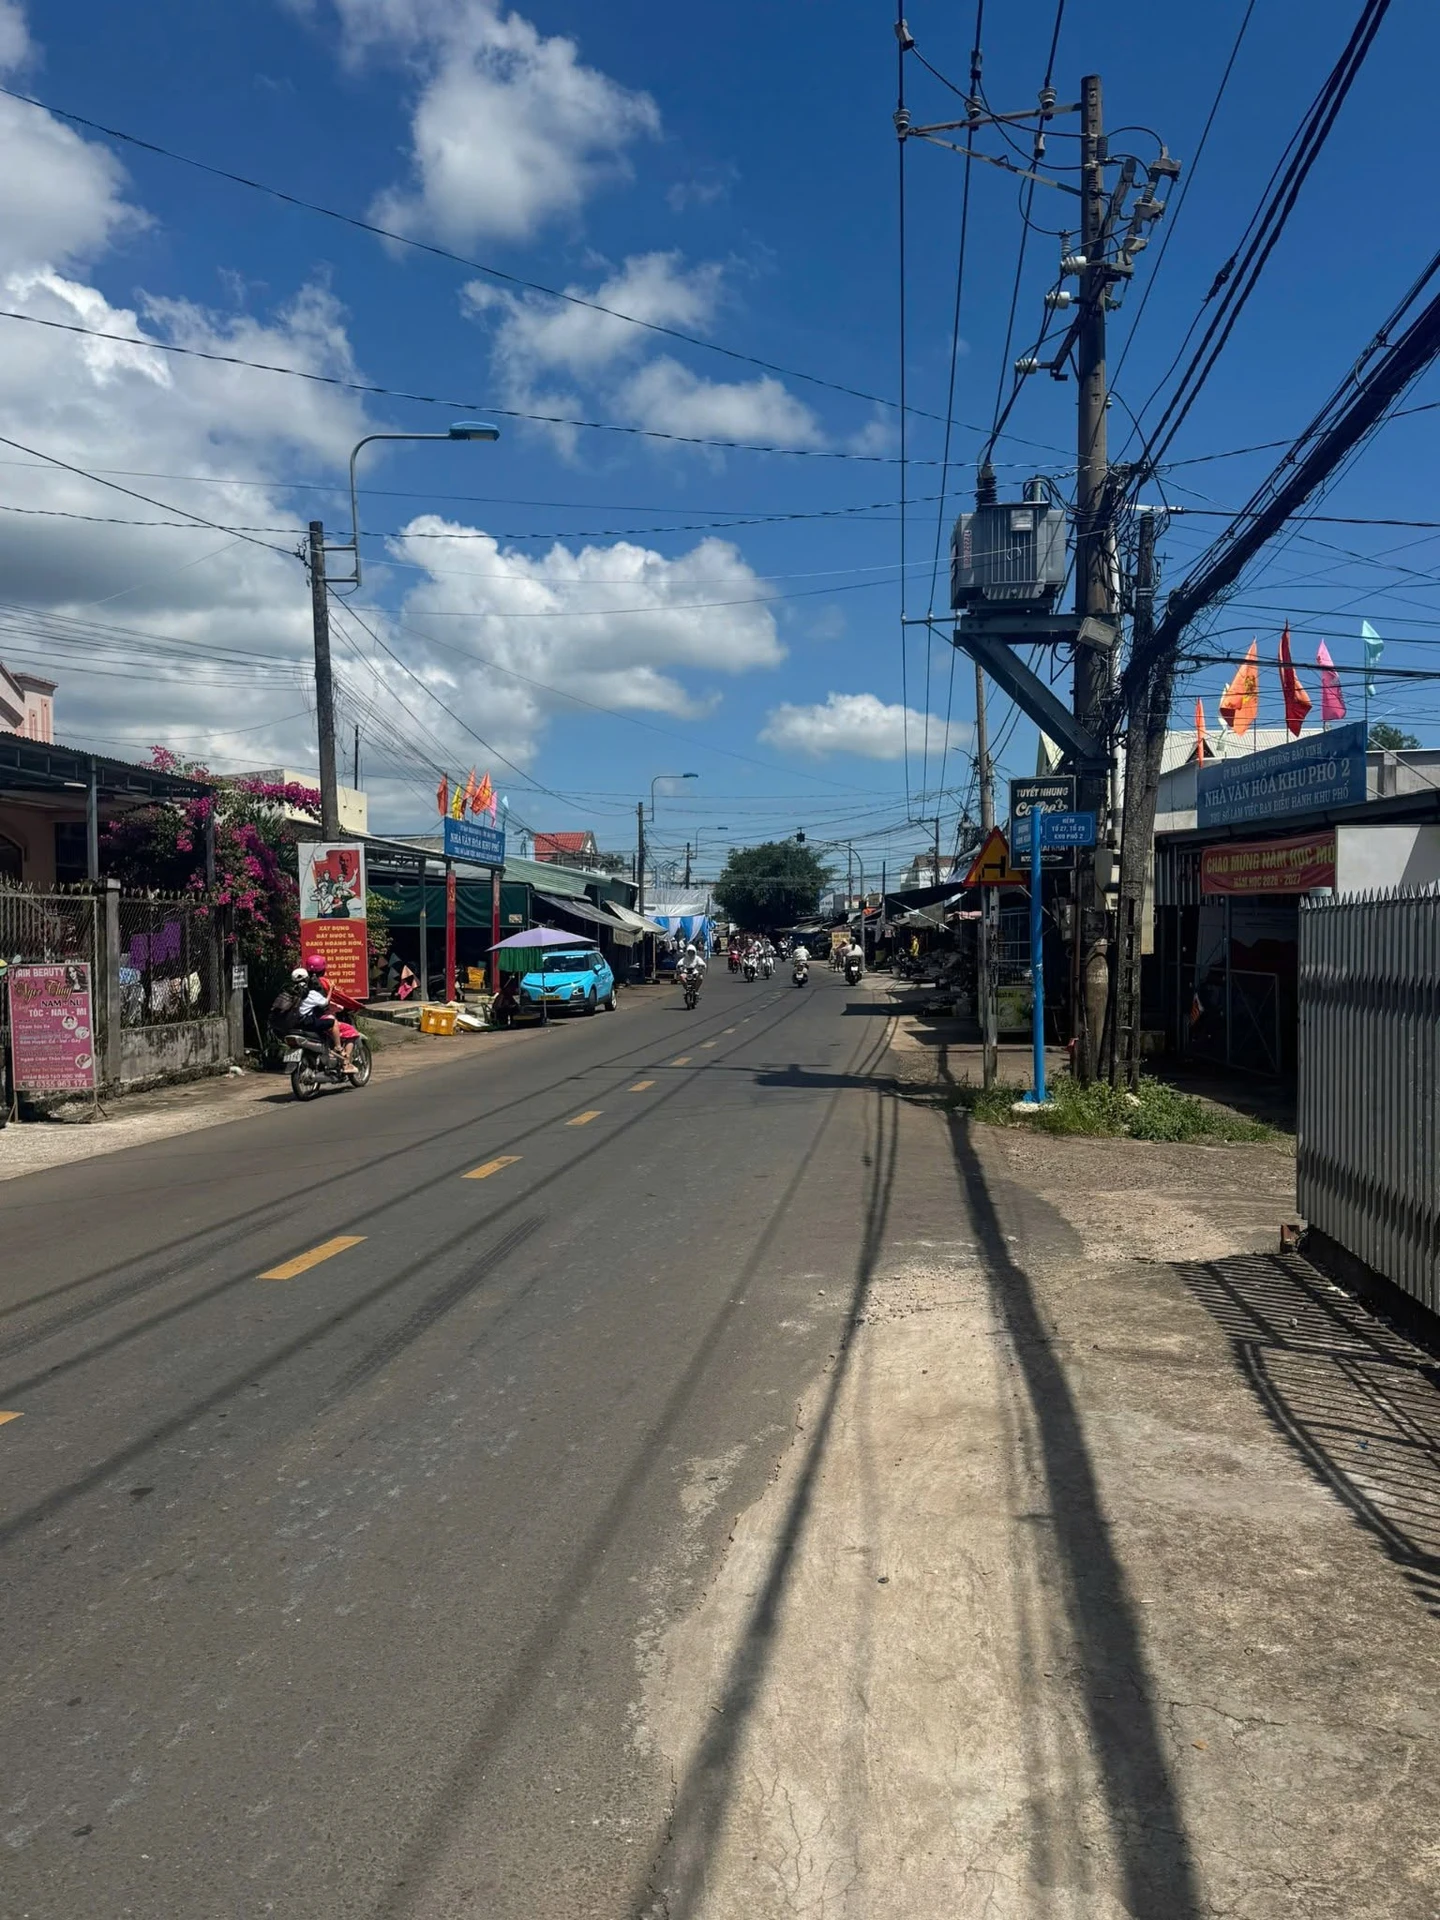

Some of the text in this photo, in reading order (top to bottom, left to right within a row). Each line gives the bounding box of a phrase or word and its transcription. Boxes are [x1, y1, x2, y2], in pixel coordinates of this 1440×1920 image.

[1204, 751, 1350, 808] NHÀ VĂN HÓA KHU PHỐ 2
[1016, 784, 1068, 798] TUYẾT NHUNG
[1314, 789, 1331, 804] KHU
[1332, 780, 1349, 800] PHỐ
[1262, 848, 1287, 869] NĂM
[1290, 847, 1313, 870] HỌC
[1316, 840, 1336, 864] MỚ
[1284, 874, 1301, 886] 2027
[33, 967, 65, 977] BEAUTY
[29, 1008, 44, 1017] TÓC
[51, 1008, 68, 1016] NAIL
